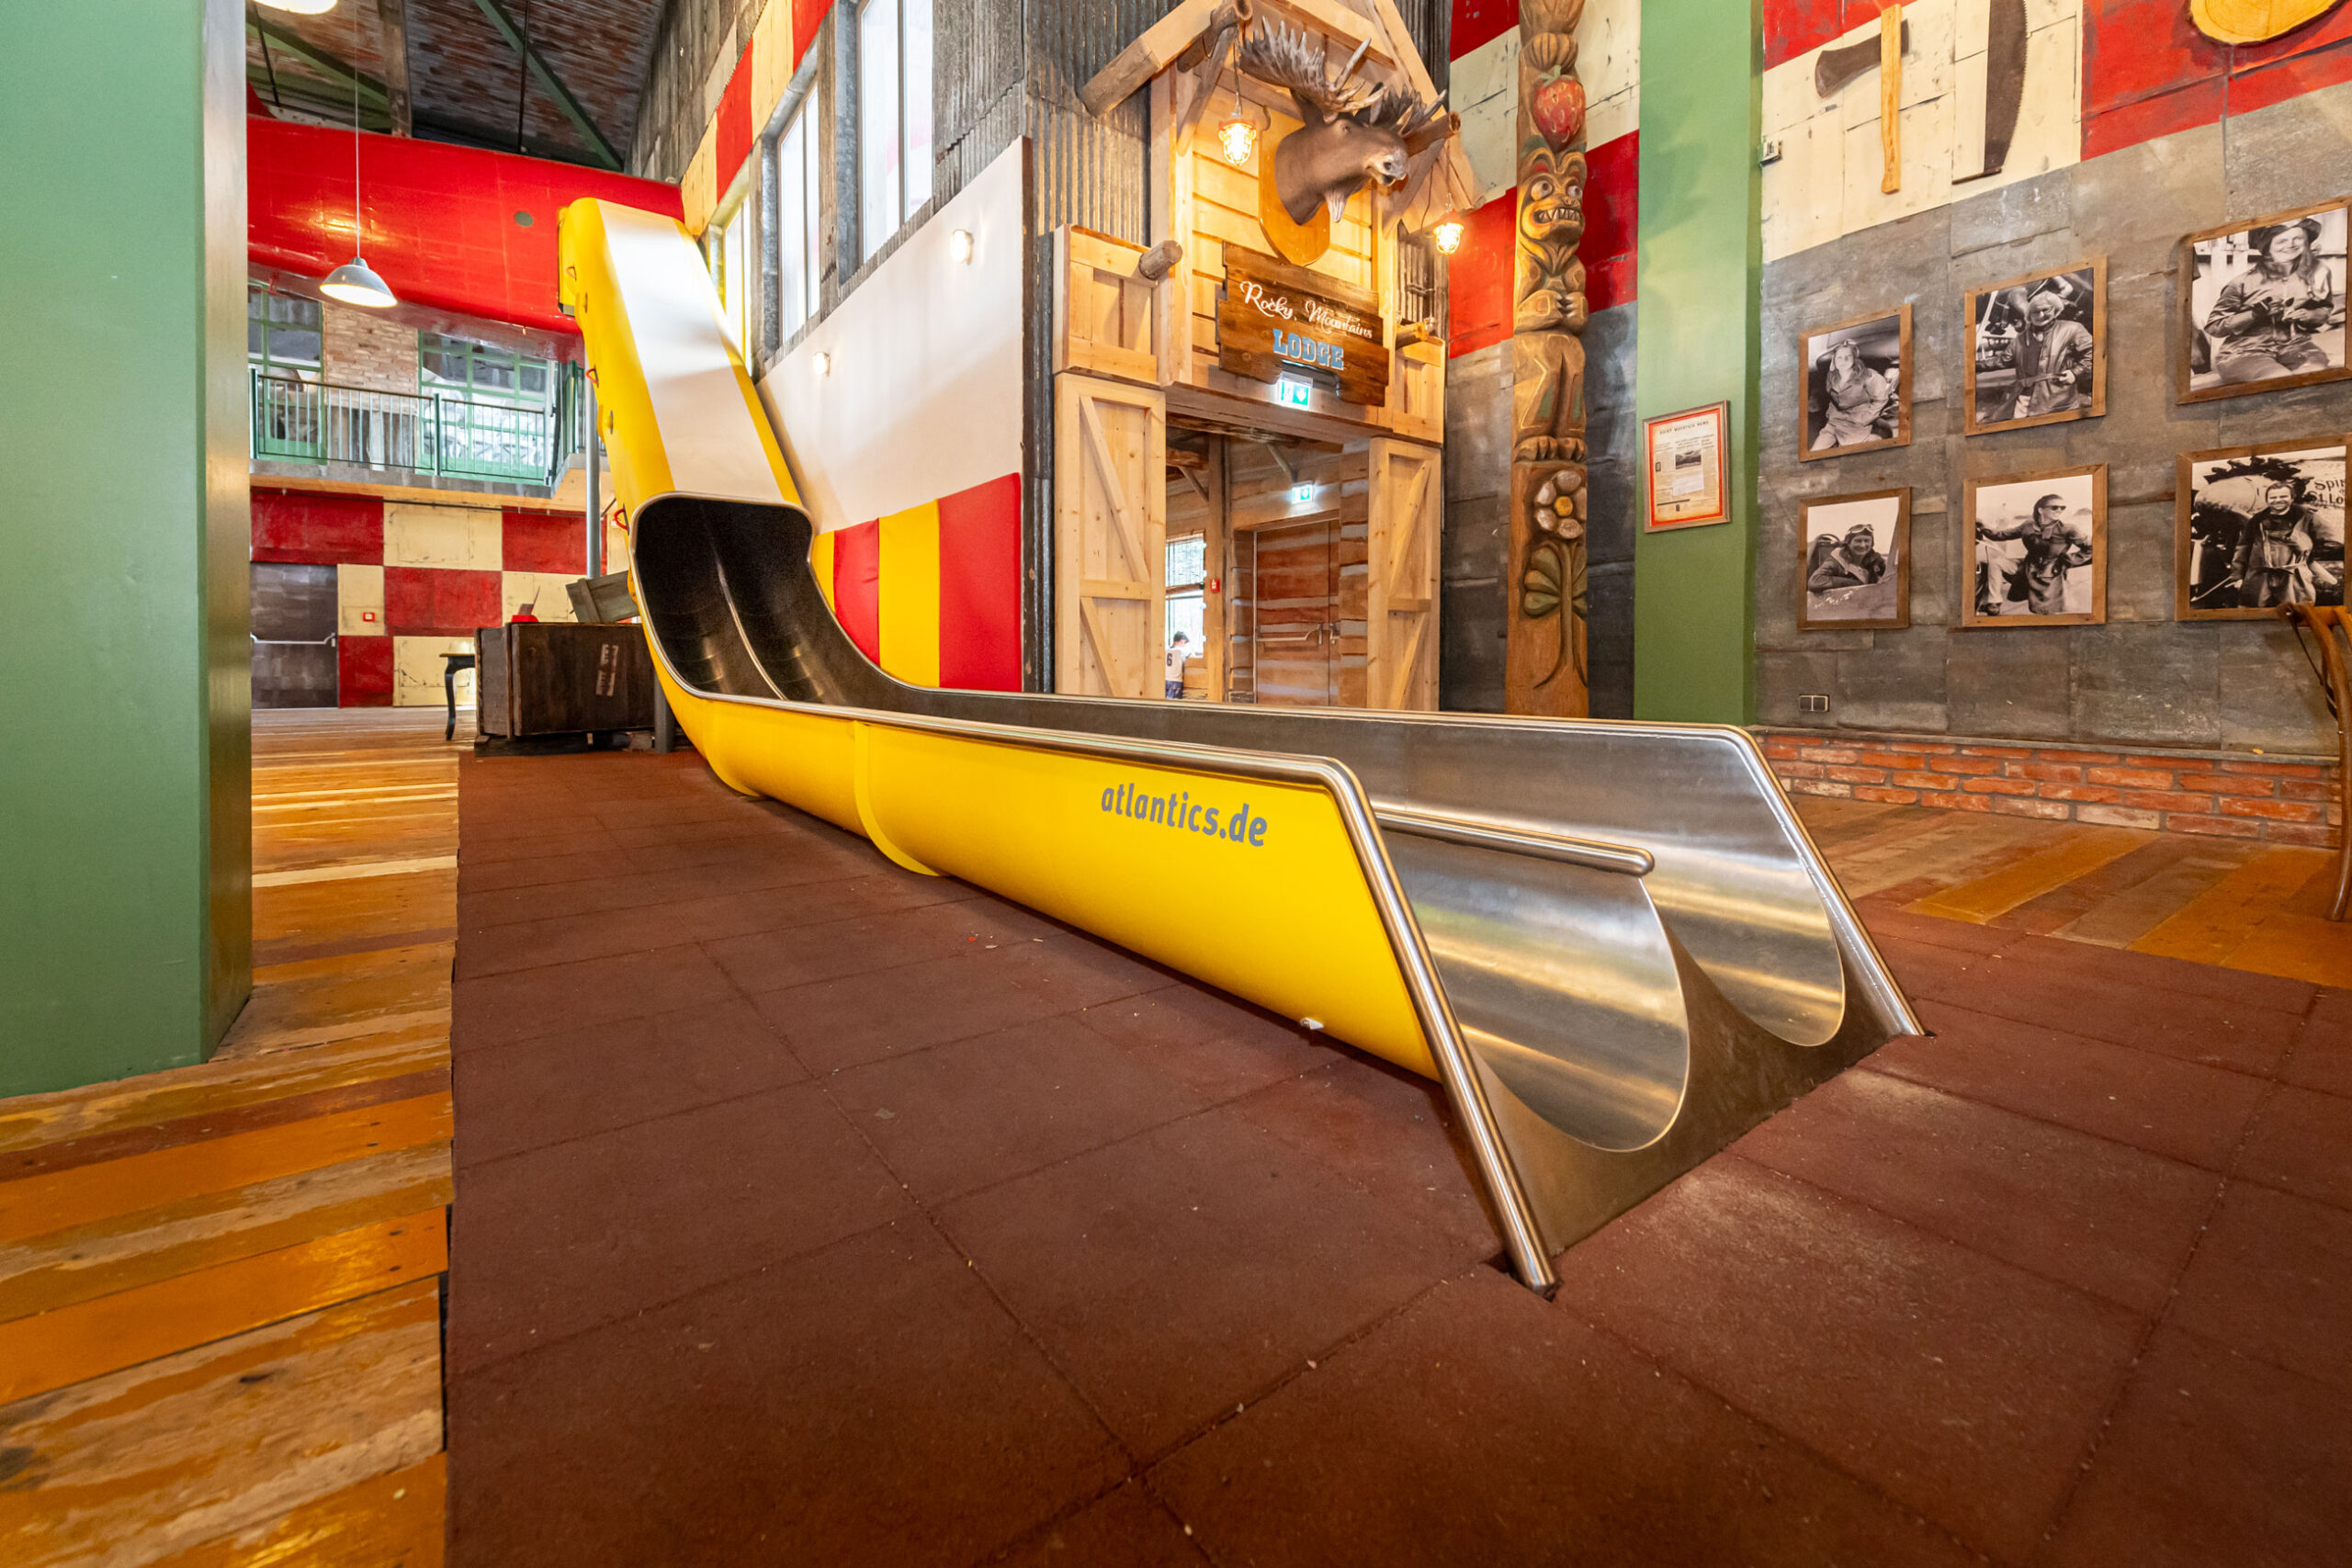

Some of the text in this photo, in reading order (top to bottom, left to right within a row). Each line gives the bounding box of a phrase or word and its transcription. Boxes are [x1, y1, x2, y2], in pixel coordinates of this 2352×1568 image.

[1239, 280, 1374, 339] Rocky Mountains
[1272, 328, 1344, 371] LODGE
[1166, 652, 1173, 667] 6
[1101, 783, 1268, 847] atlantics.de
